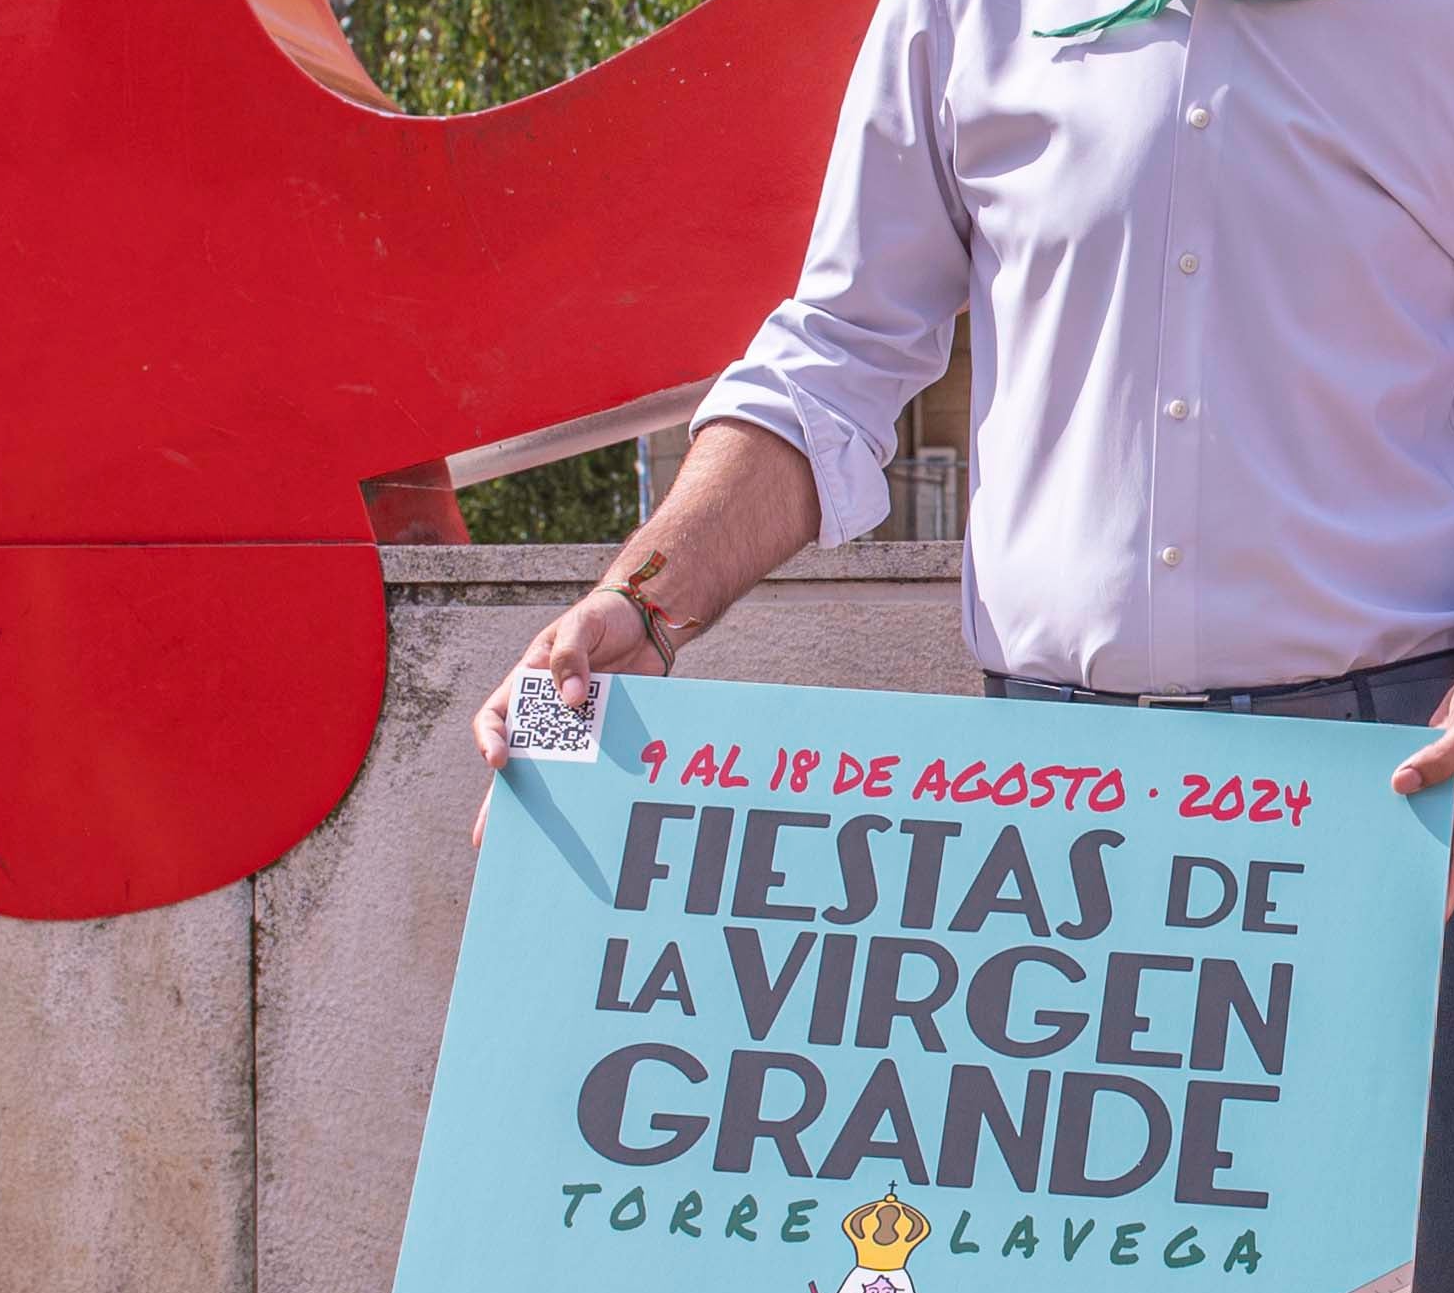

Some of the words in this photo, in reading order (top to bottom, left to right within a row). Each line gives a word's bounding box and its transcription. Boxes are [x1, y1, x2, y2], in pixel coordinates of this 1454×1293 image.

[640, 739, 668, 784] 9
[679, 743, 750, 789] AL
[768, 748, 821, 794] 18
[832, 751, 900, 799] DE
[911, 758, 1126, 814] AGOSTO
[1178, 773, 1312, 827] 2024
[613, 800, 1127, 942] FIESTAS
[1164, 854, 1306, 936] DE
[594, 937, 697, 1017] LA
[722, 925, 1295, 1077] VIRGEN
[576, 1041, 1282, 1210] GRANDE
